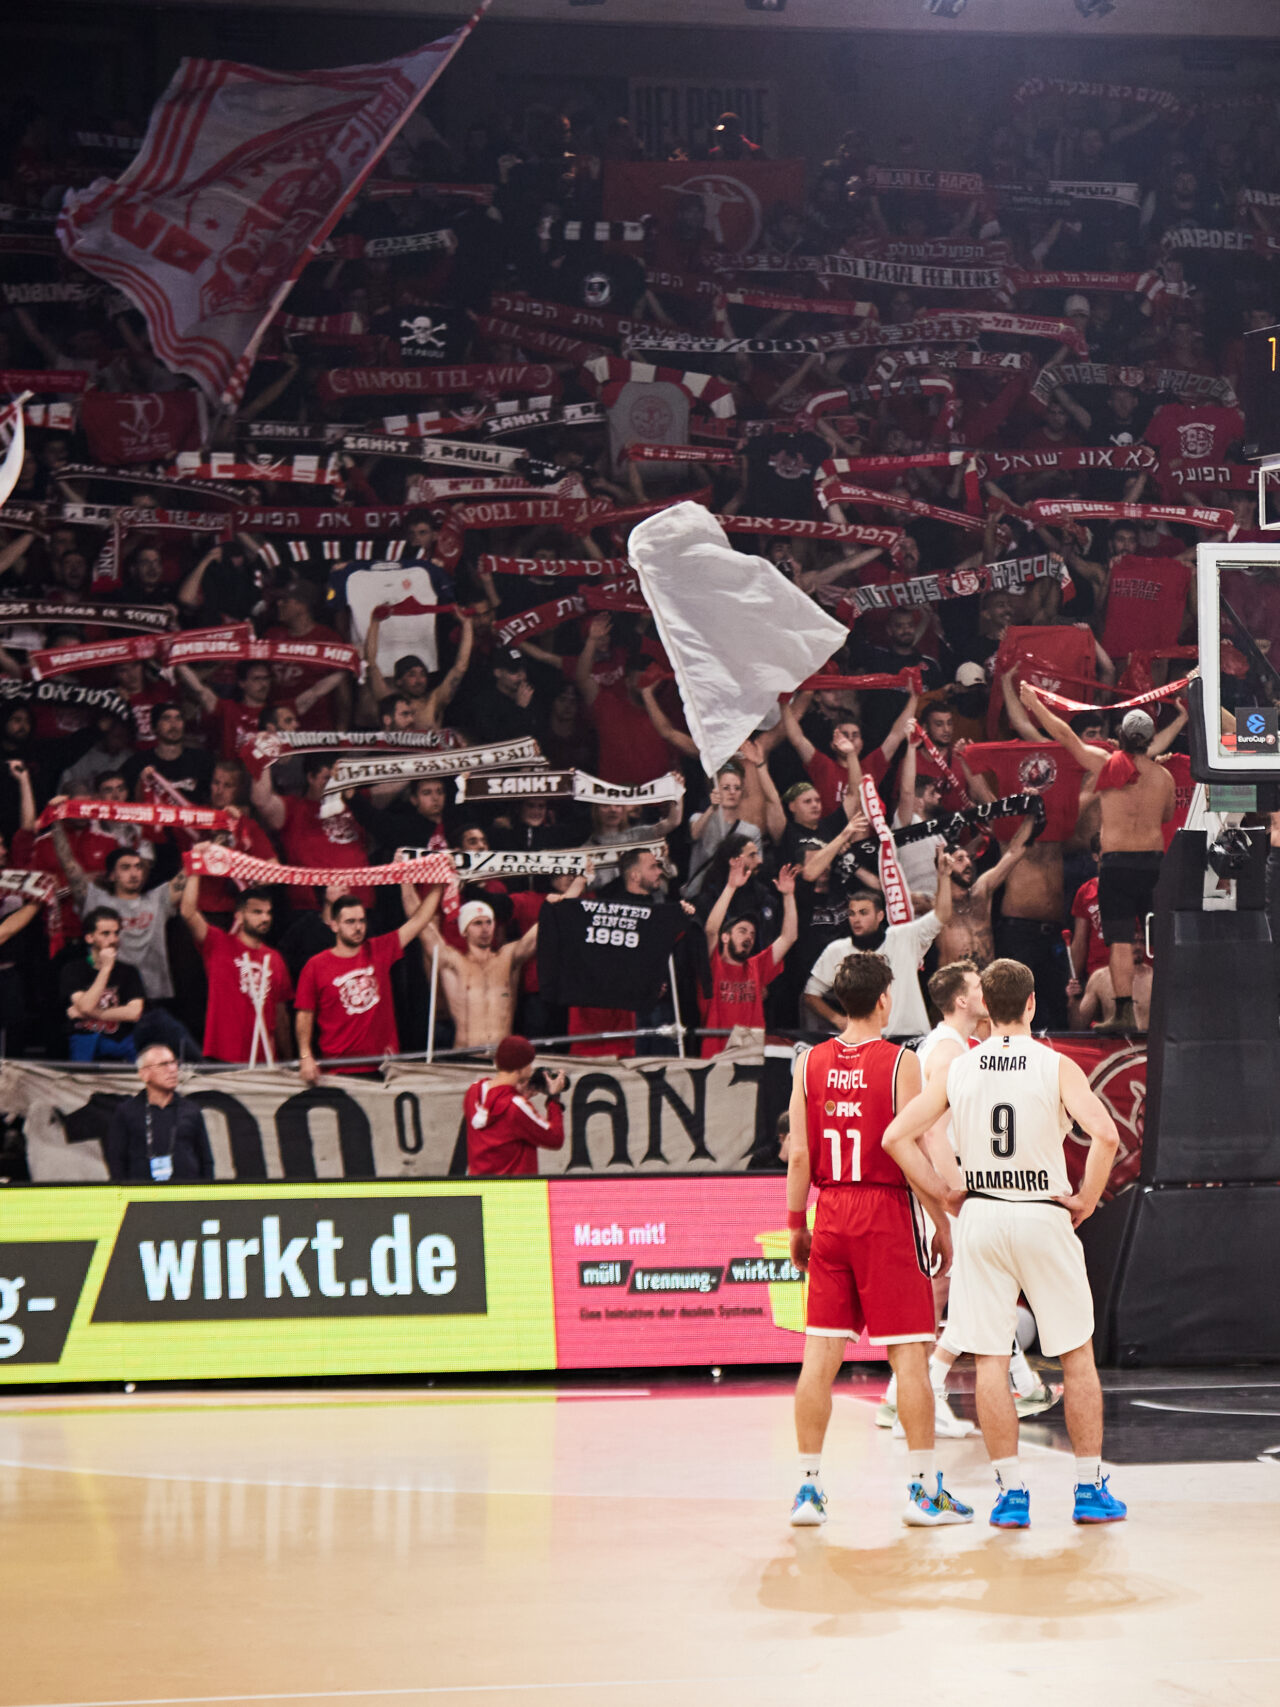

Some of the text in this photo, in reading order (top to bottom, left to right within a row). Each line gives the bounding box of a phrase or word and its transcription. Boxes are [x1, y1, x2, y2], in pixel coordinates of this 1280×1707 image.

[442, 445, 502, 463] PAULI
[780, 518, 817, 534] תל
[822, 521, 899, 545] הפועל
[171, 641, 240, 657] AMBURG
[1237, 735, 1267, 745] EuroCup
[487, 777, 655, 797] SANKT PAULI
[925, 794, 1031, 834] PAULI
[502, 855, 584, 866] ANTI
[580, 899, 652, 920] WANTED
[591, 915, 638, 932] SINCE
[584, 927, 640, 949] 1999
[979, 1055, 1027, 1071] SAMAR
[826, 1069, 868, 1090] ARIEL
[990, 1101, 1017, 1160] 9
[823, 1128, 862, 1182] 11
[964, 1169, 1049, 1192] HAMBURG
[575, 1222, 667, 1247] Mach mit!
[140, 1213, 457, 1300] wirkt.de
[583, 1261, 622, 1285] müll
[732, 1259, 801, 1282] wirkt.de
